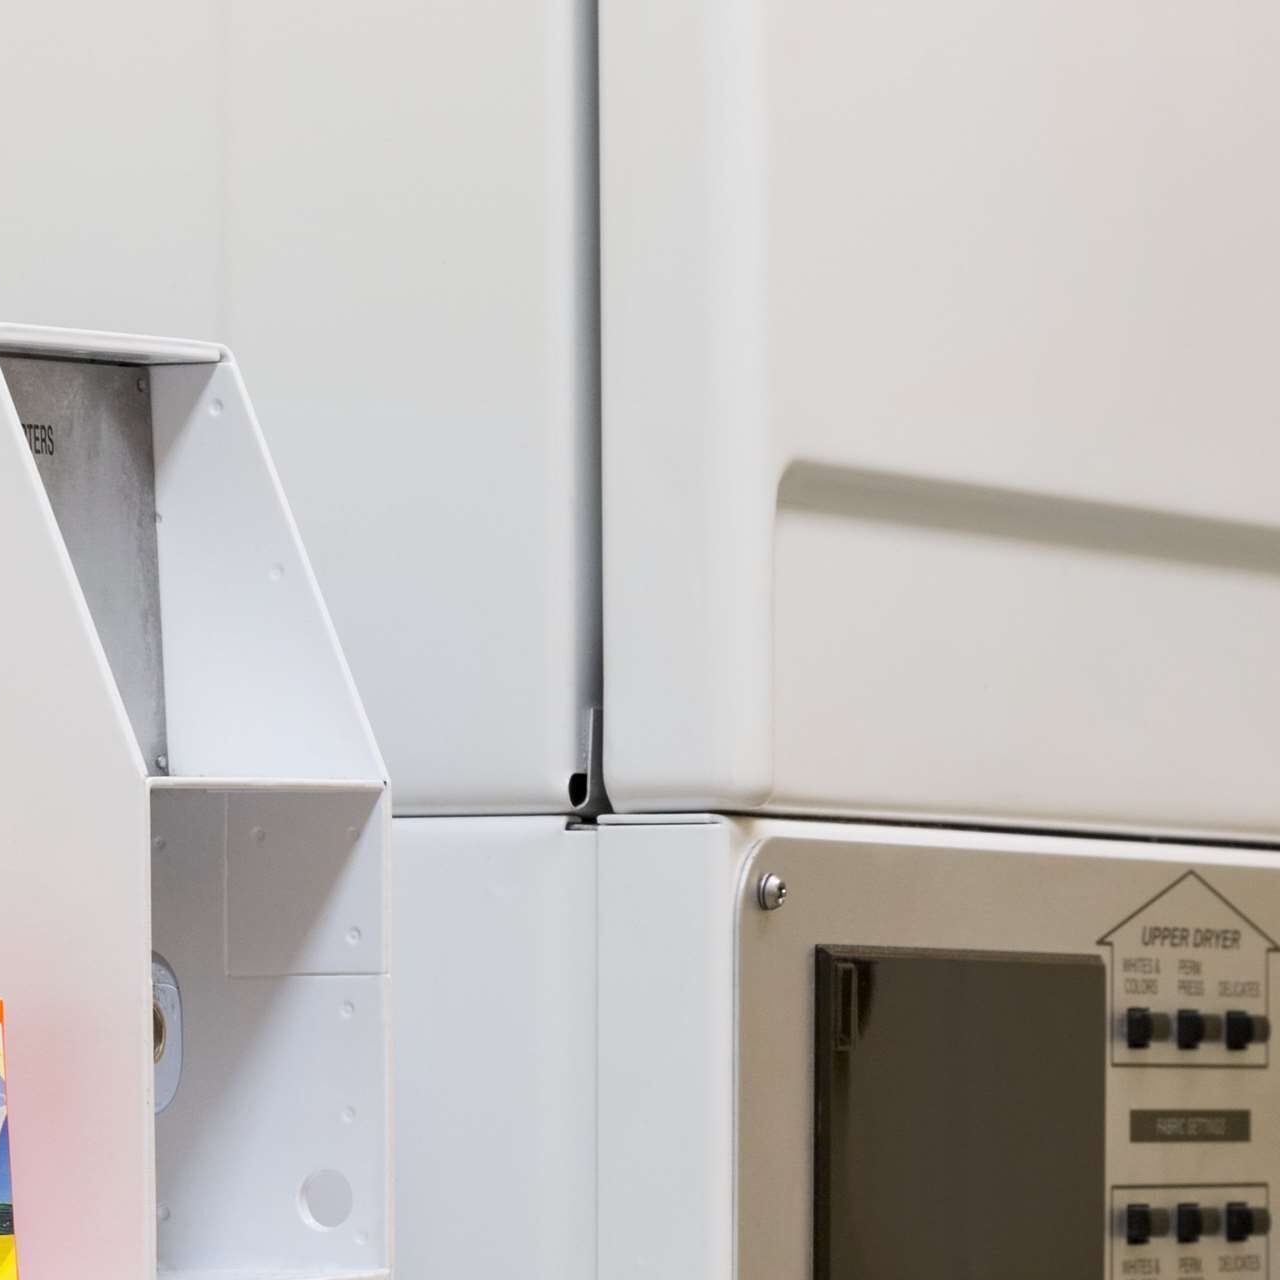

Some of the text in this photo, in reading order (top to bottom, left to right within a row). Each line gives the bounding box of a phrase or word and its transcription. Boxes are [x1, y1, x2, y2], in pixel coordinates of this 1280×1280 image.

[21, 423, 55, 456] TERS
[1141, 926, 1241, 949] UPPER DRYER
[1124, 978, 1158, 995] COLORS
